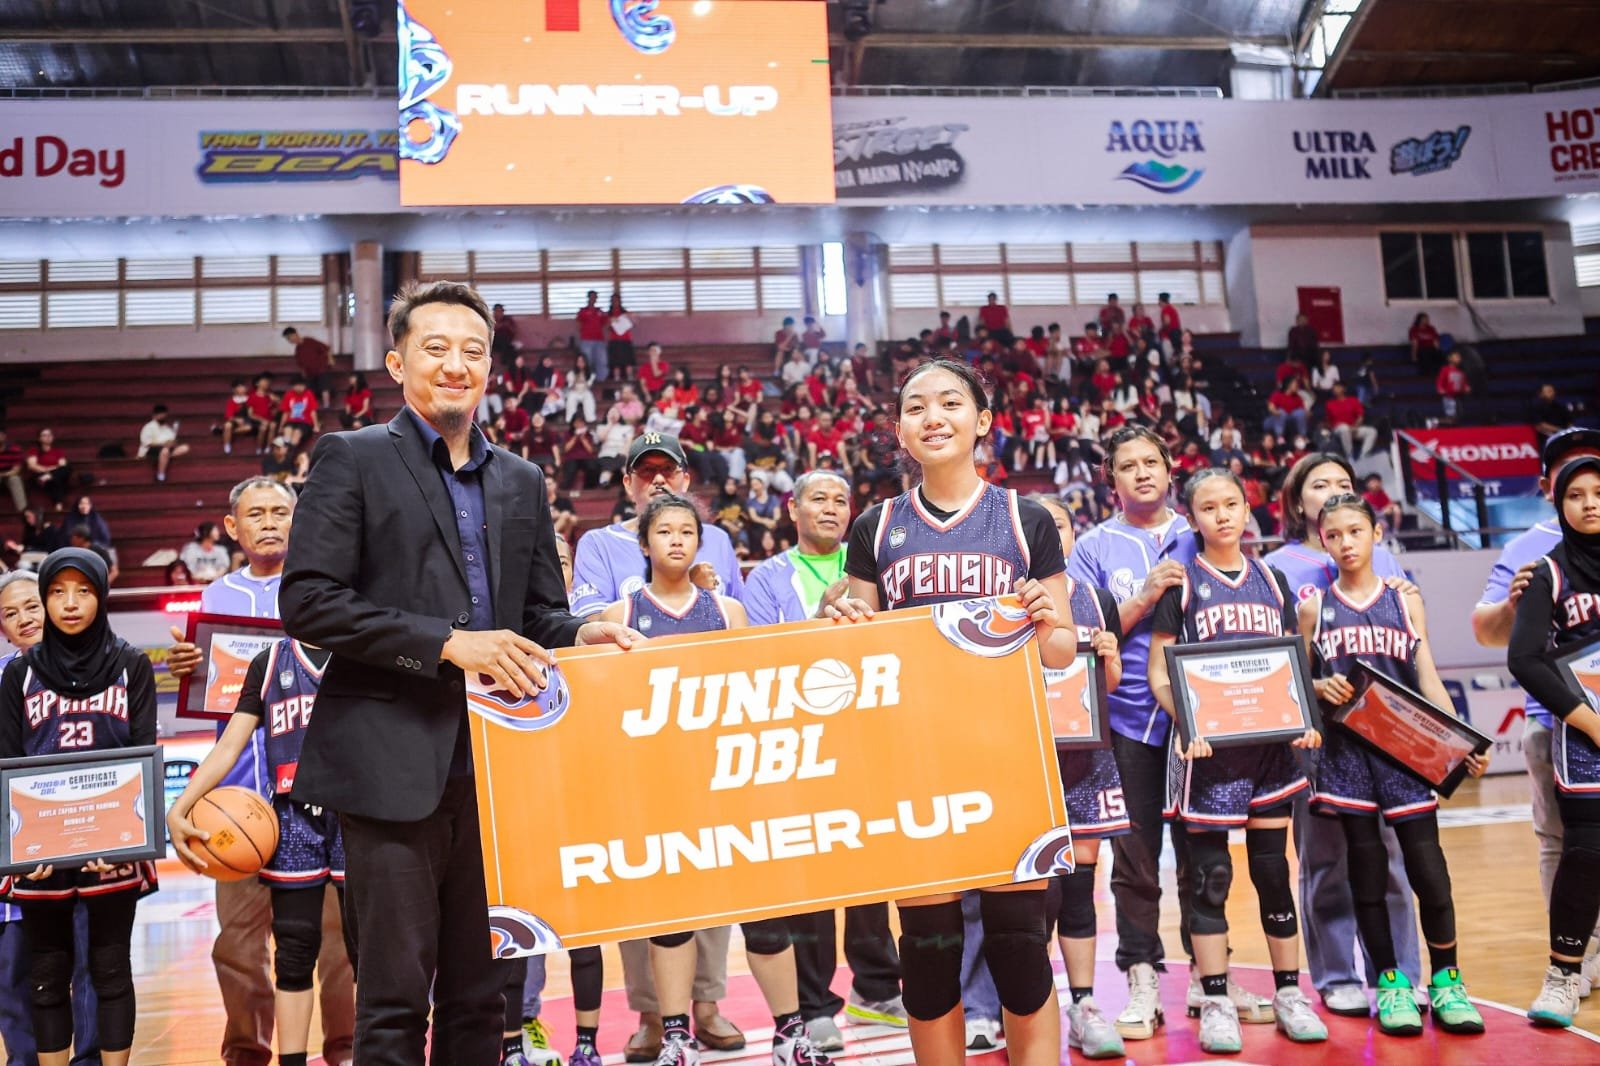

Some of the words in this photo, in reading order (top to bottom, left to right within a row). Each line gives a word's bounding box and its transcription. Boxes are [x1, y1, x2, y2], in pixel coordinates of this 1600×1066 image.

[456, 84, 779, 116] RUNNER-UP
[202, 133, 261, 148] YANG
[264, 133, 342, 148] WORTH
[1106, 119, 1205, 158] AQUA
[1292, 131, 1377, 154] ULTRA
[35, 136, 126, 188] Day
[1305, 157, 1372, 180] MILK
[1440, 442, 1540, 463] HONDA
[881, 551, 1014, 610] SPENSIX
[1230, 658, 1270, 669] CERTIFICATE
[621, 653, 900, 738] JUNIOR
[60, 720, 94, 749] 23
[710, 724, 837, 791] DBL
[30, 779, 66, 790] JUNIOR
[68, 771, 118, 785] CERTIFICATE
[81, 780, 118, 790] ACHIEVEMENT
[1098, 788, 1127, 820] 15
[559, 790, 994, 889] RUNNER-UP
